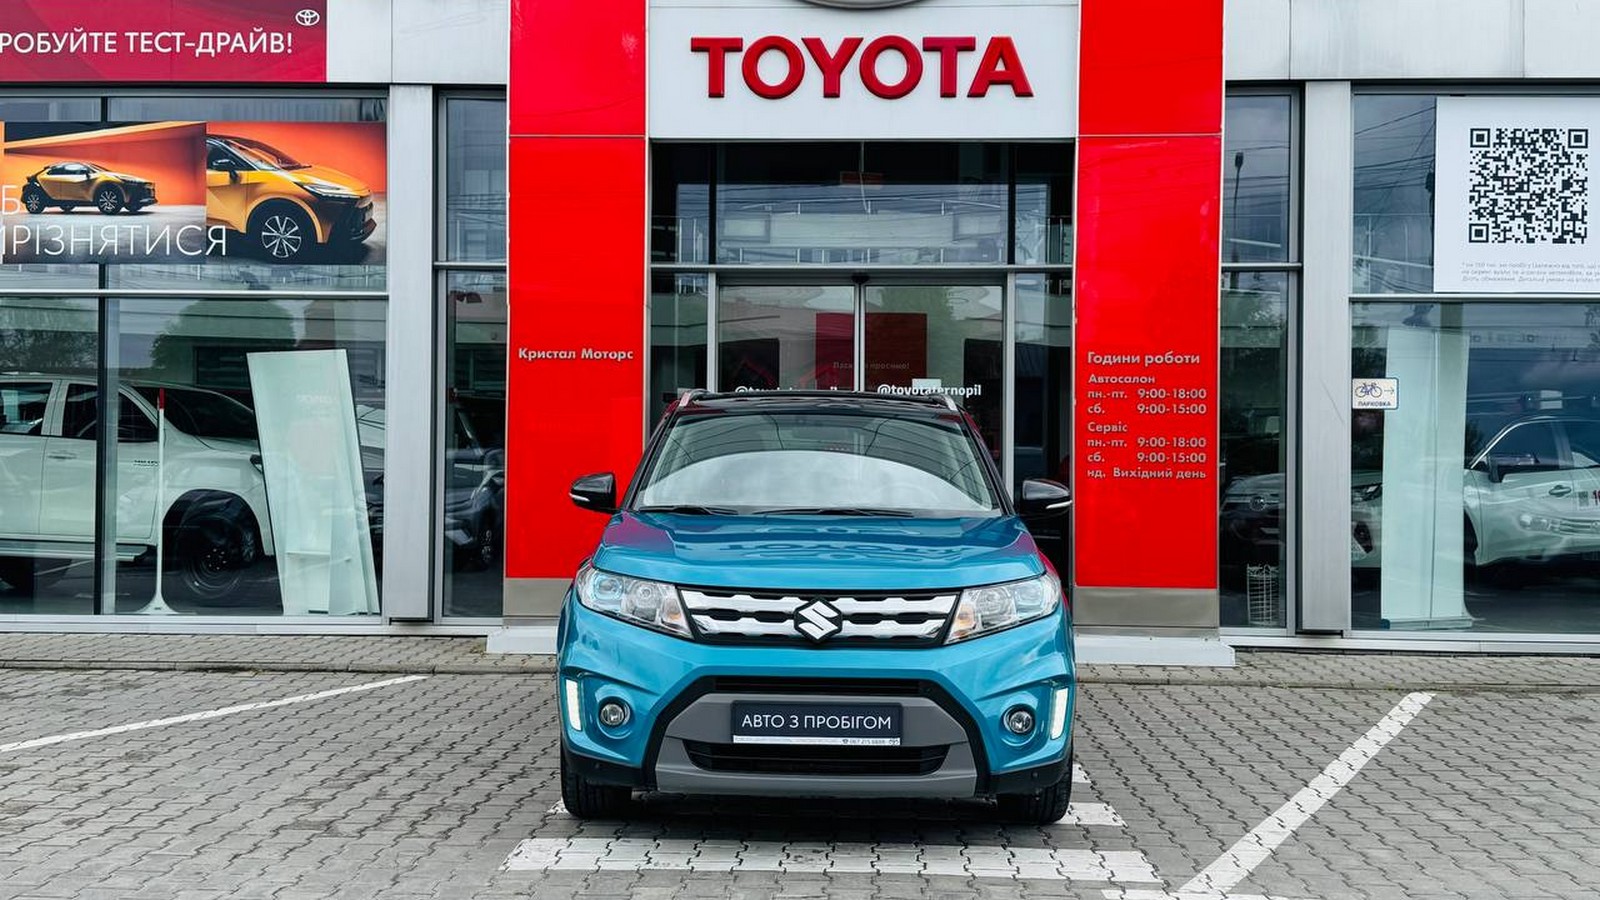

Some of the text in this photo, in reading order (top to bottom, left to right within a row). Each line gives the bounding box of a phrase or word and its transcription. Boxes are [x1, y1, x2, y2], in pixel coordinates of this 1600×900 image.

[0, 27, 293, 57] РОБУЙТЕ ТЕСТ-ДРАЙВ!
[690, 35, 1034, 100] TOYOTA
[518, 347, 633, 362] Кристал Моторс
[1087, 350, 1200, 367] Години роботи
[1088, 373, 1156, 384] Автосалон
[1087, 388, 1207, 399] пн.-пт. 9:00-18:00
[1087, 402, 1207, 414] сб. 9:00-15:00
[1087, 421, 1128, 434] Сервіс
[1087, 437, 1207, 448] пн.-пт. 9:00-18:00
[1087, 452, 1207, 463] сб. 9:00-15:00
[1087, 466, 1206, 479] нд. Вихідний день
[741, 714, 891, 730] АВТО З ПРОБІГОМ
